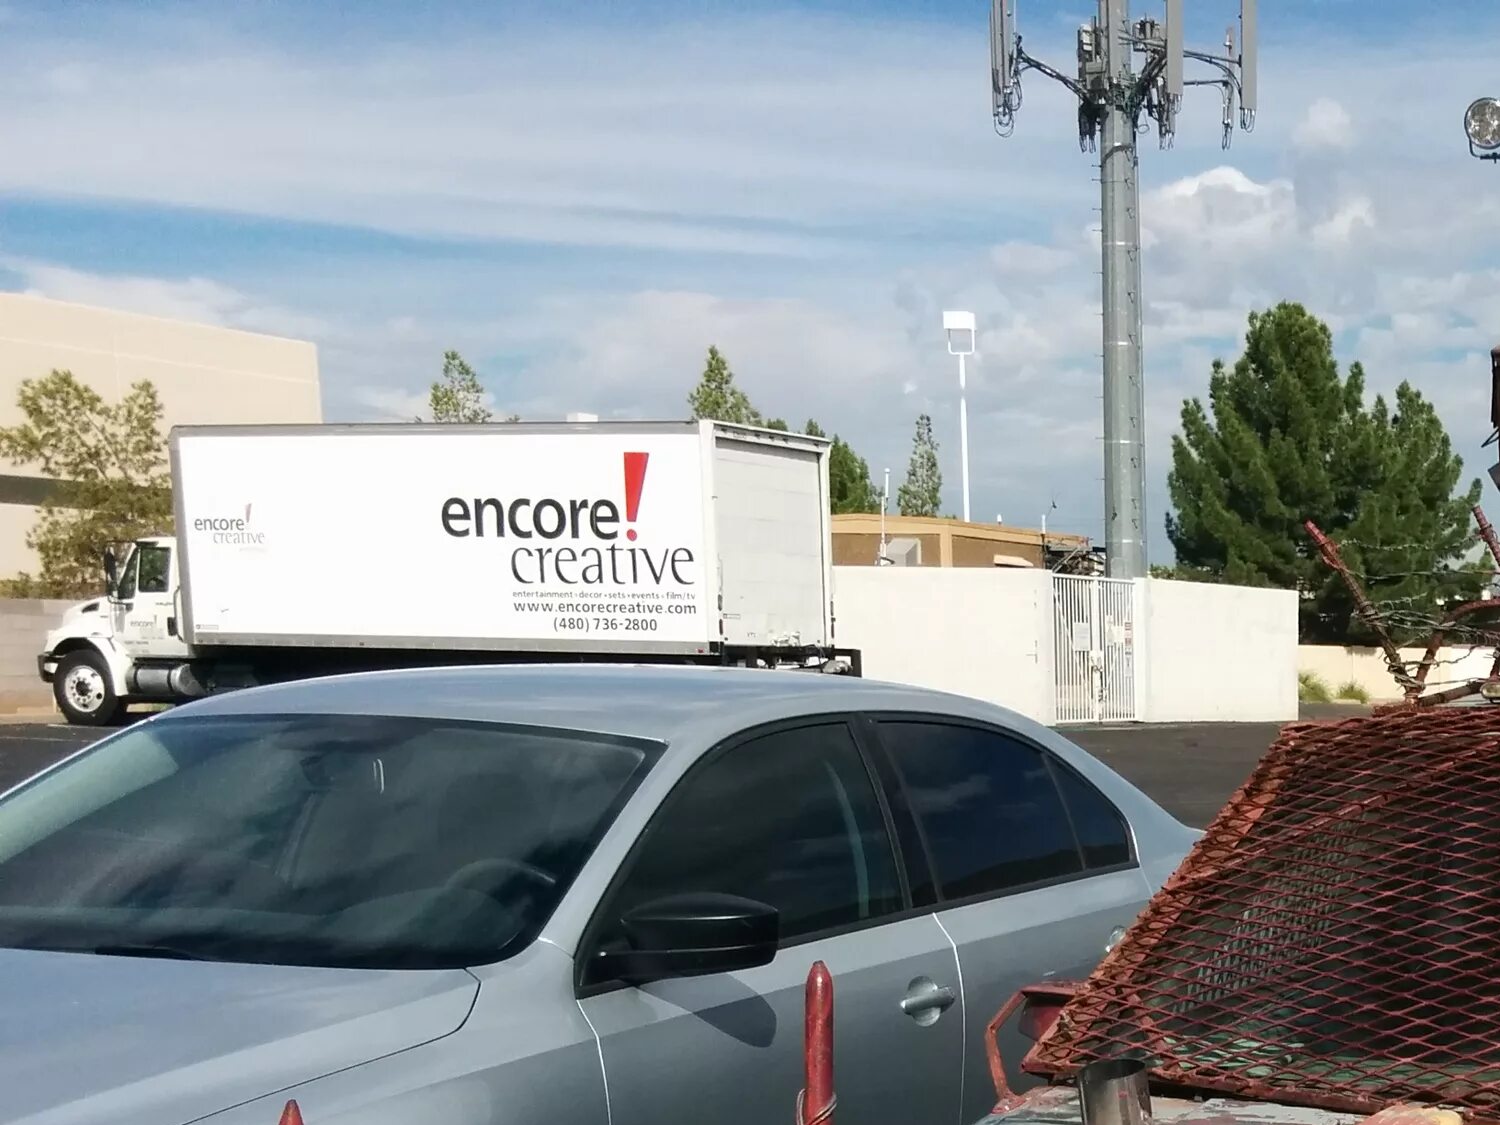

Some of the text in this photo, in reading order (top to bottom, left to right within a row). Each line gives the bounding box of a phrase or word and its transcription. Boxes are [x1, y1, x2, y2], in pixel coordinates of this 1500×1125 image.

[441, 452, 650, 541] encore!
[212, 531, 265, 545] creative
[510, 543, 696, 585] creative
[512, 590, 573, 599] entertainment
[578, 590, 603, 599] decor
[608, 591, 626, 600] sets
[631, 592, 660, 600] events
[513, 602, 697, 615] www.encorecreative.com
[553, 616, 658, 632] (480) 736-2800
